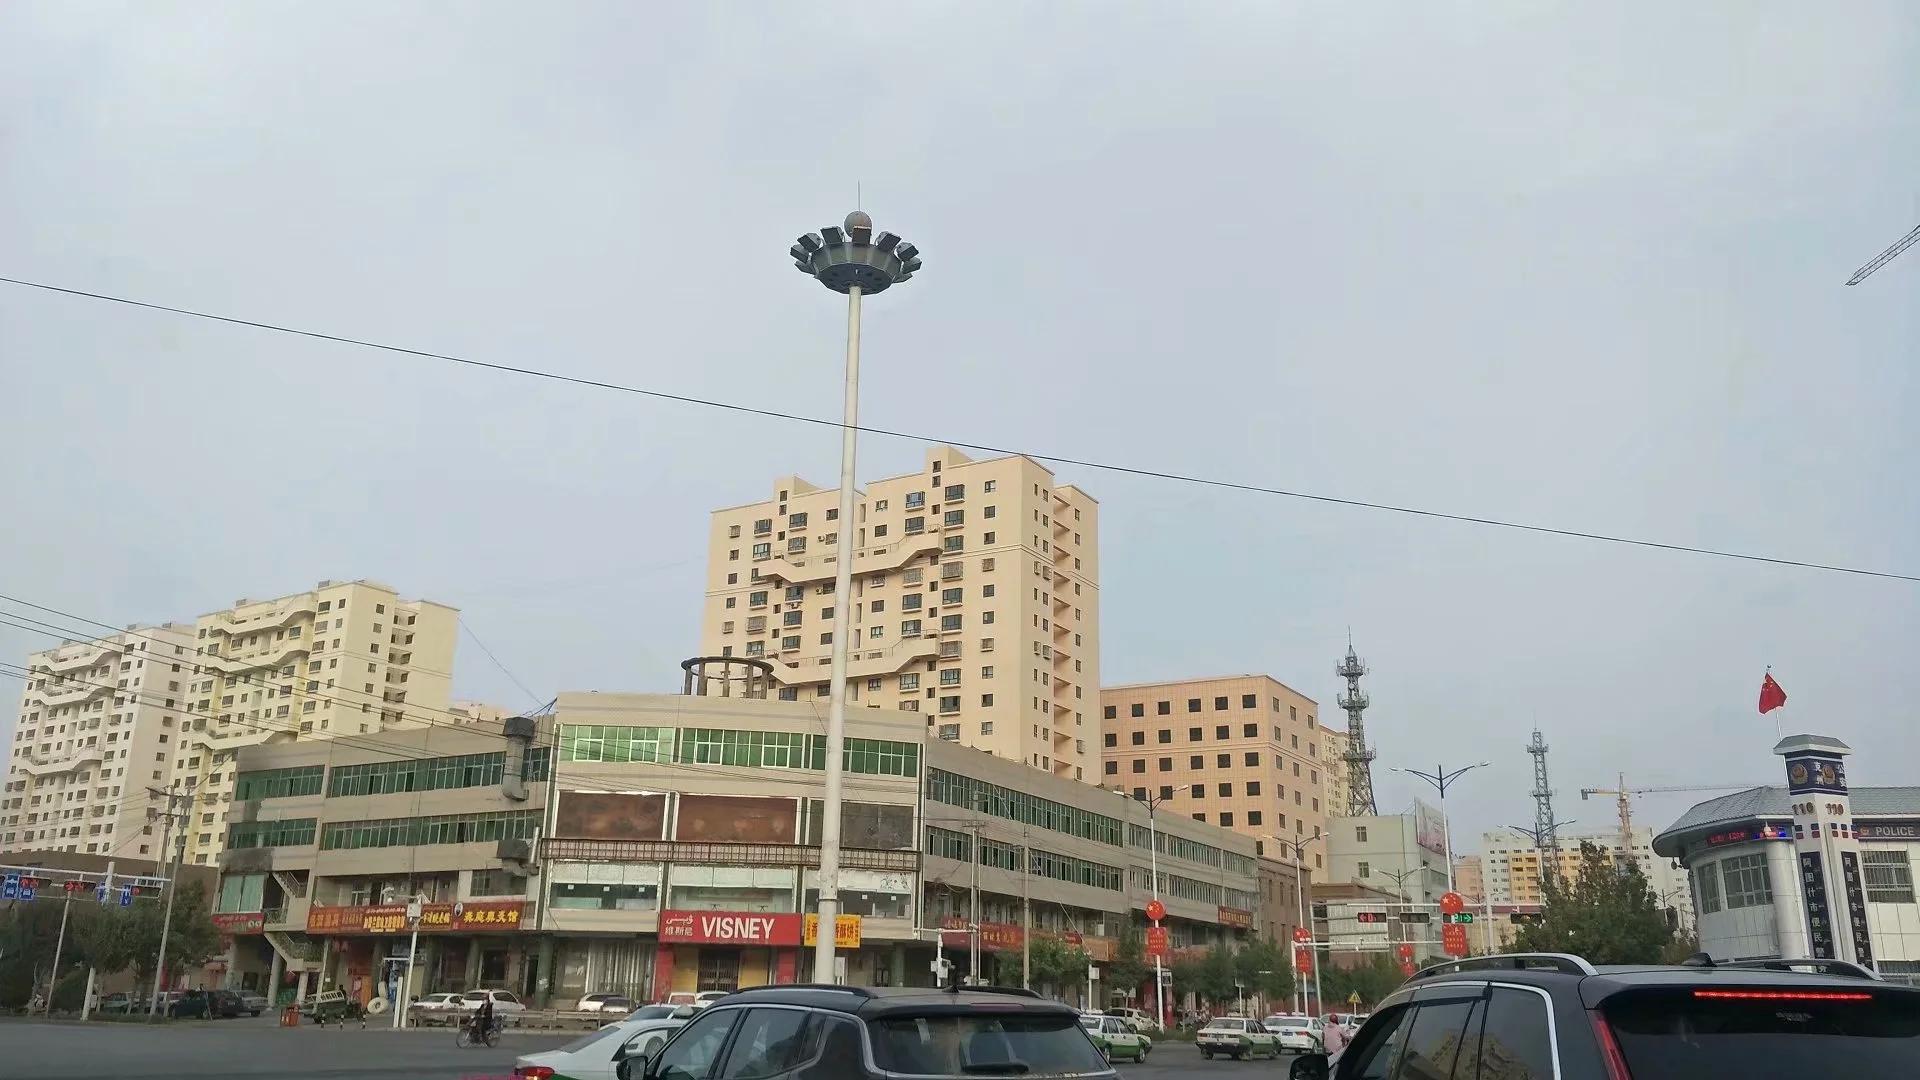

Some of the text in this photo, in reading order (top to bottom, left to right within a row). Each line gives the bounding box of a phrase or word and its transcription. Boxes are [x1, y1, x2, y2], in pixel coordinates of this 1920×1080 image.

[1792, 802, 1814, 815] 110
[1825, 803, 1844, 815] 110
[1875, 825, 1915, 837] POLICE
[701, 915, 775, 939] VISNEY
